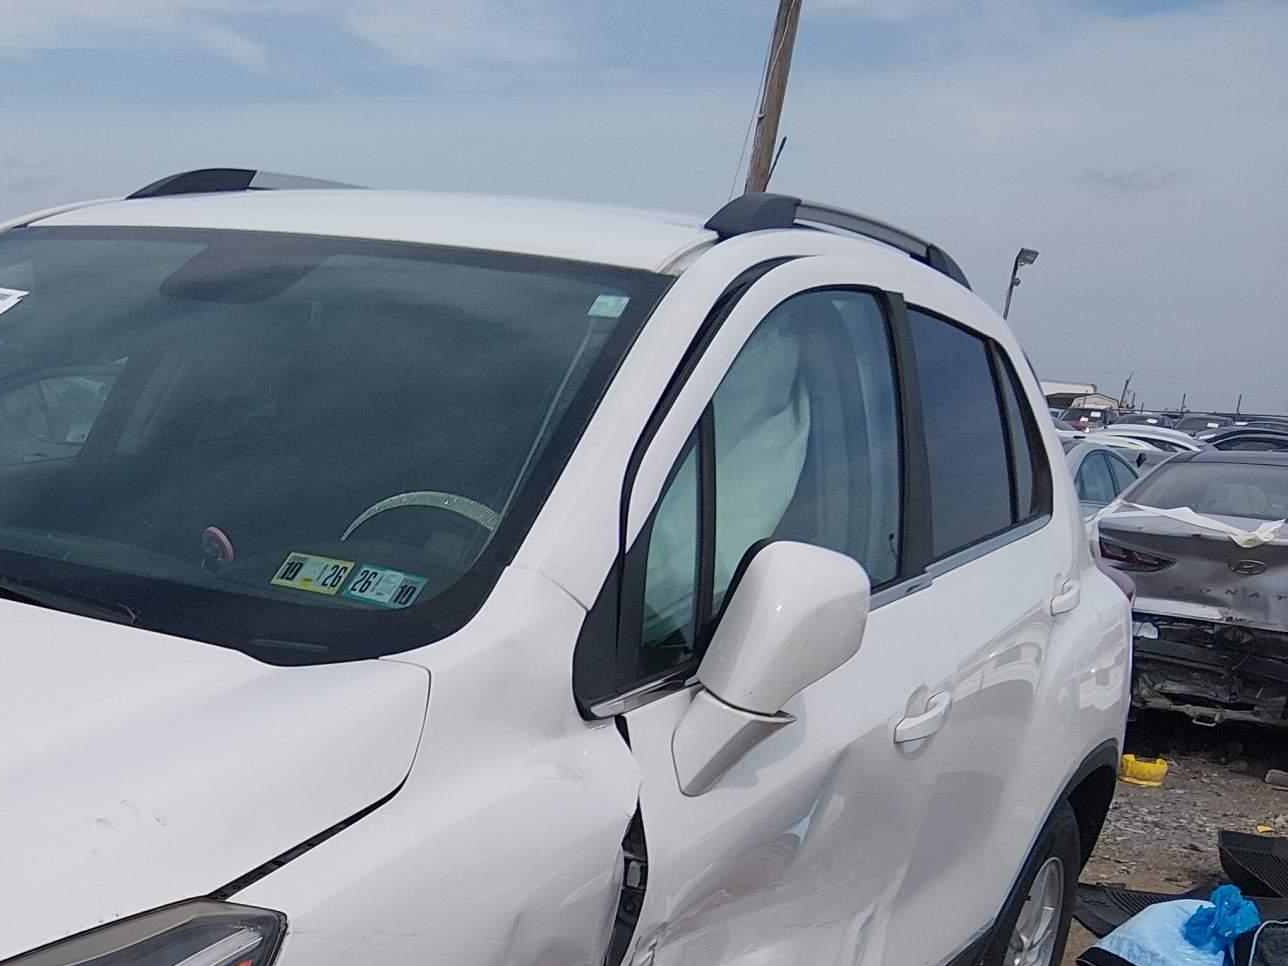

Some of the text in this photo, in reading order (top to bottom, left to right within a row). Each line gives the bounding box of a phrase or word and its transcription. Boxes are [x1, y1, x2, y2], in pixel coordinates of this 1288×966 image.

[280, 561, 348, 588] 10 26
[350, 569, 417, 606] 26 10
